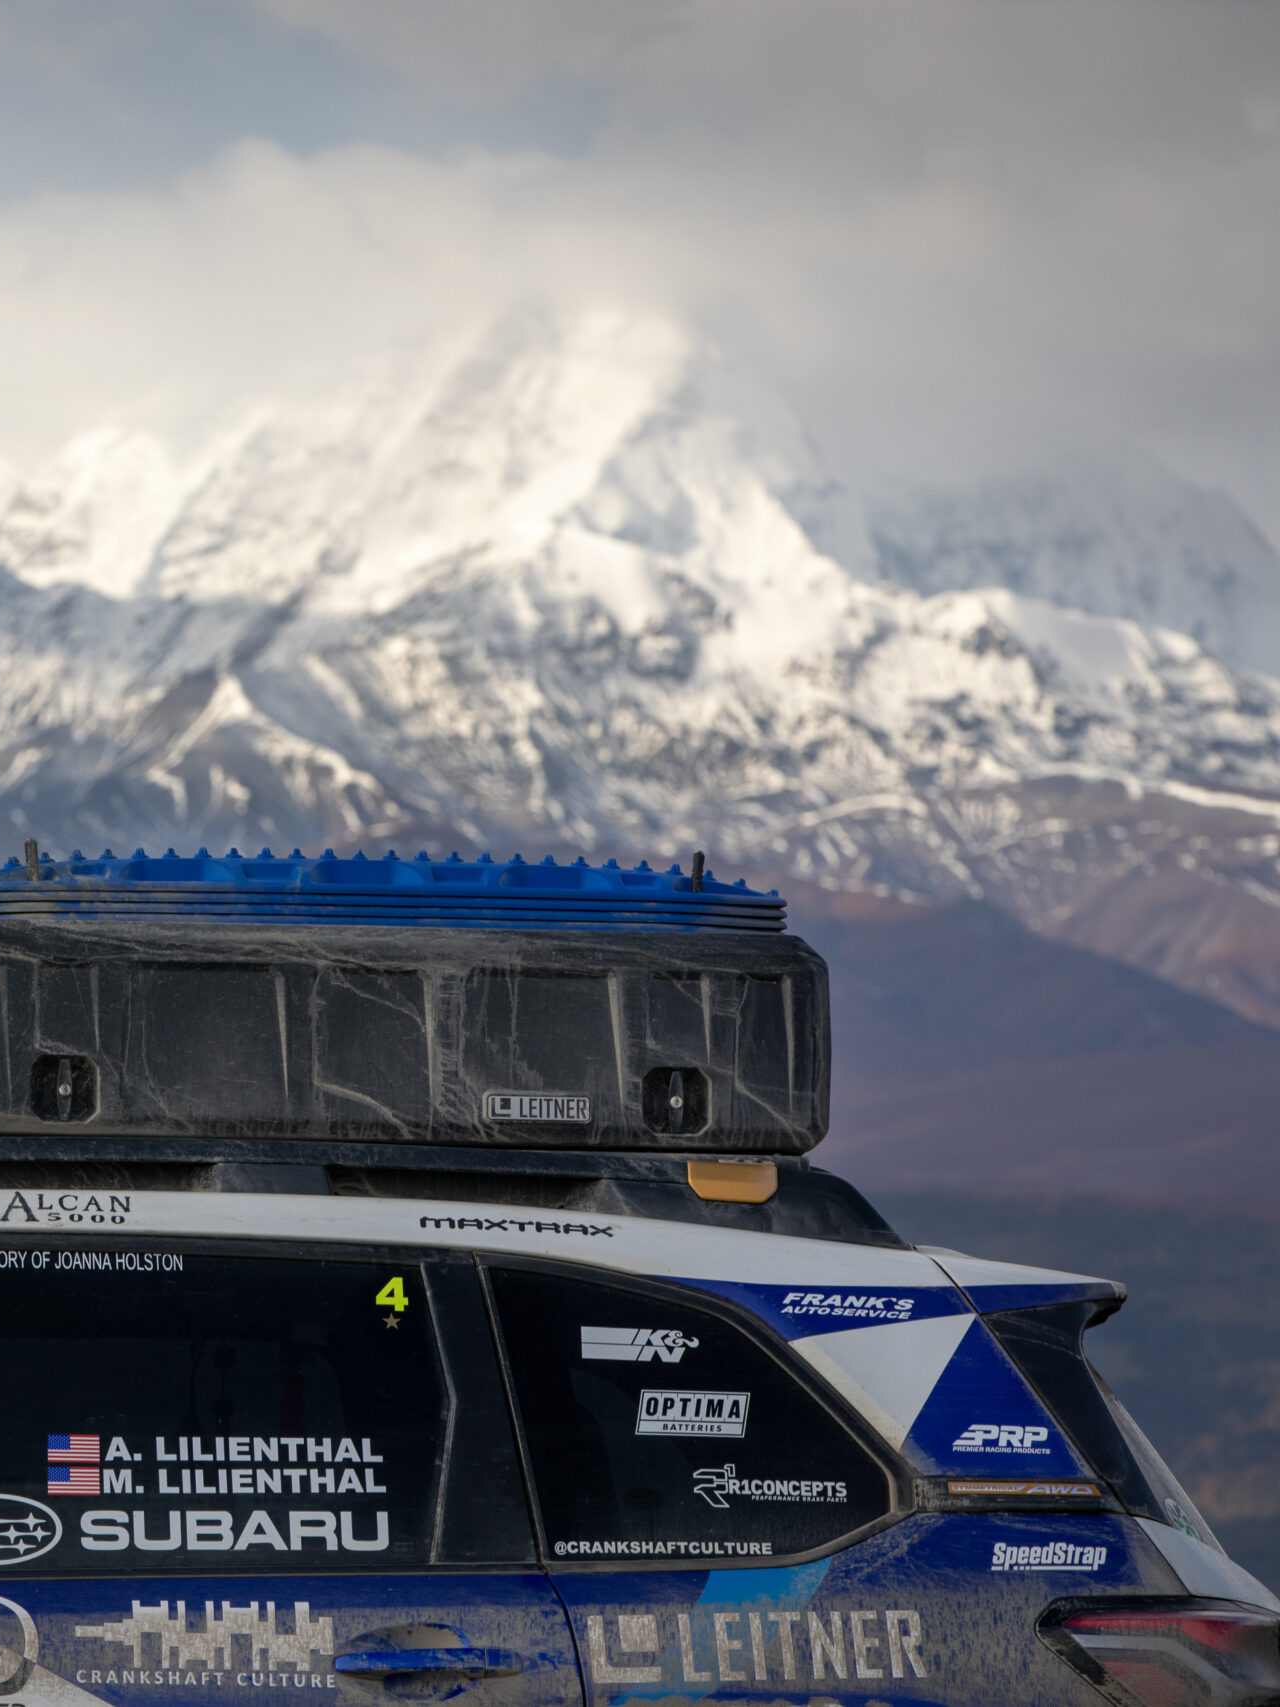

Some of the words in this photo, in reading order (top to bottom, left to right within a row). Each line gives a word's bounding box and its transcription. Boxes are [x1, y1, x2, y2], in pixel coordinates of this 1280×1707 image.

[519, 1098, 587, 1119] LEITNER
[48, 1213, 125, 1224] 5000
[420, 1216, 613, 1237] MAXTRAX
[31, 1251, 50, 1269] OF
[55, 1252, 112, 1270] JOANNA
[116, 1253, 183, 1271] HOLSTON
[376, 1277, 409, 1312] 4
[645, 1397, 741, 1419] OPTIMA
[662, 1423, 723, 1432] BATTERIES
[952, 1424, 1048, 1447] PRP
[105, 1436, 142, 1461] A.
[155, 1436, 383, 1463] LILIENTHAL
[952, 1445, 984, 1453] PREMIER
[1013, 1446, 1051, 1455] PRODUCTS
[103, 1468, 144, 1494] M.
[158, 1468, 386, 1494] LILIENTHAL
[728, 1478, 847, 1497] R1CONCEPTS
[1026, 1485, 1093, 1495] AWD
[80, 1510, 390, 1551] SUBARU
[554, 1541, 773, 1556] @CRANKSHAFTCULTURE
[991, 1542, 1107, 1571] SpeedStrap
[677, 1610, 928, 1682] LEITNER
[76, 1669, 224, 1686] CRANKSHAFT
[236, 1672, 336, 1689] CULTURE
